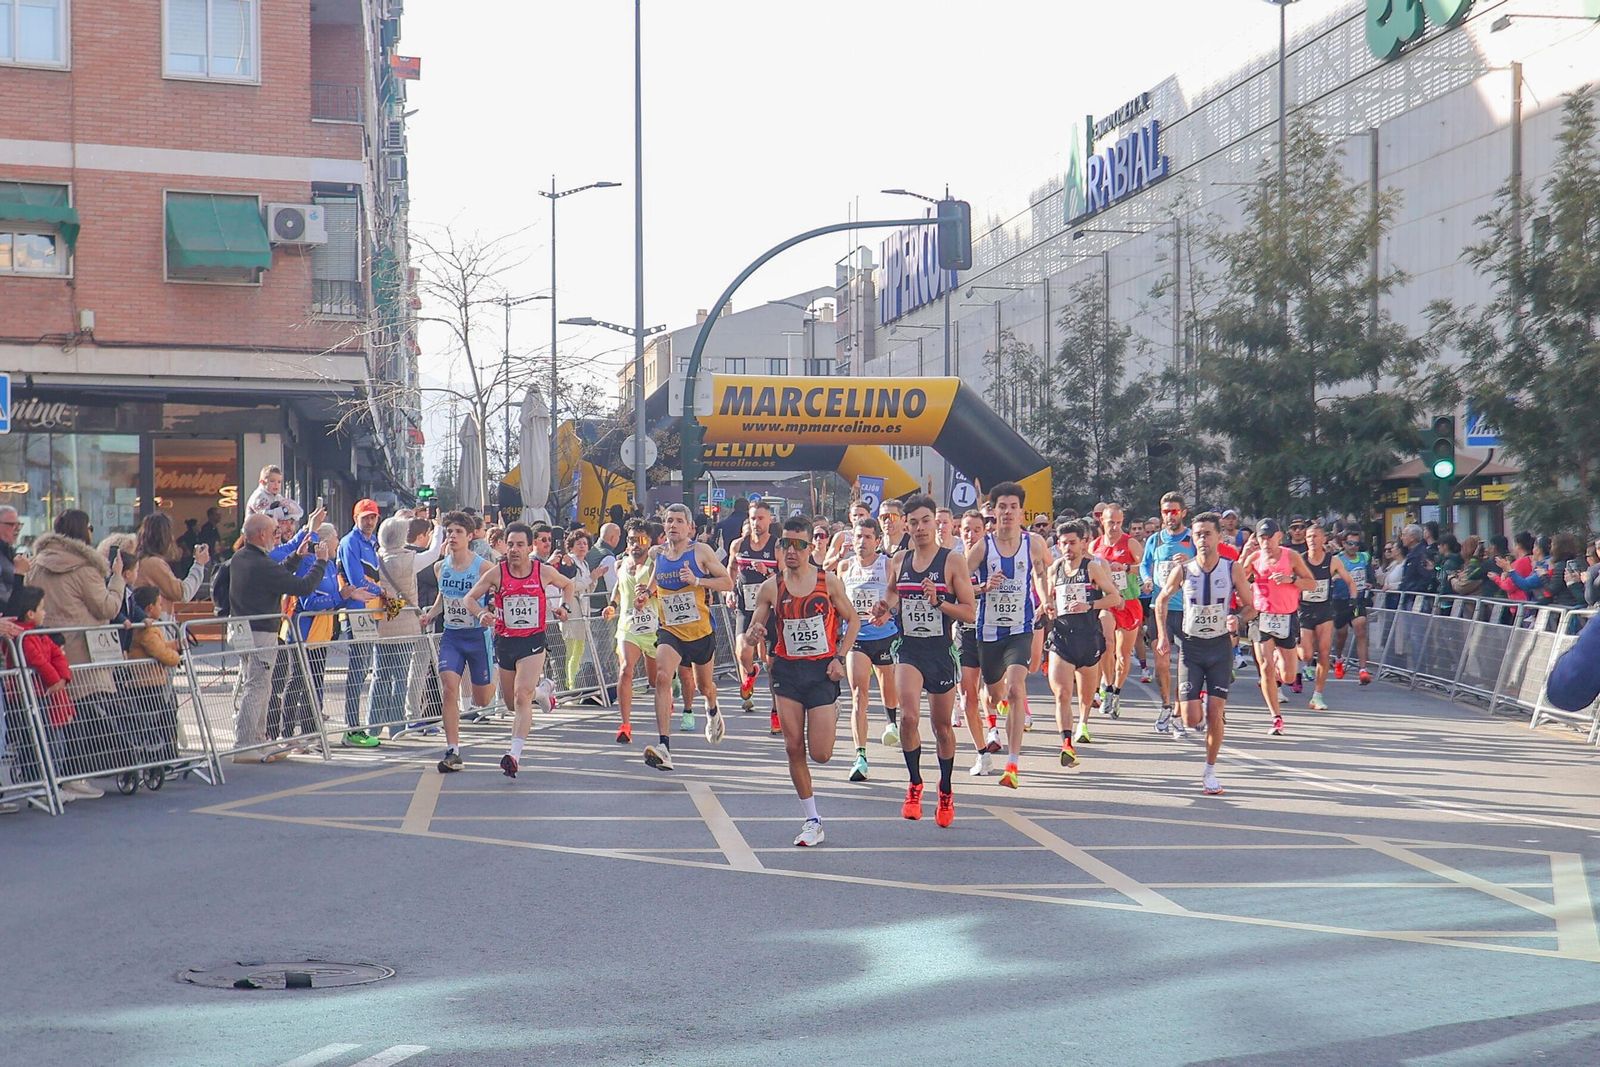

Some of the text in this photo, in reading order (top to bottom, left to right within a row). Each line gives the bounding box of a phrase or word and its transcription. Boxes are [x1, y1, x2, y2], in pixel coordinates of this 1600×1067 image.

[718, 386, 927, 418] MARCELINO
[742, 421, 902, 436] www.mpmarcelino.es
[959, 486, 970, 504] 1
[442, 578, 473, 591] nerja
[447, 606, 467, 616] 2948
[510, 607, 532, 616] 1941
[668, 602, 691, 613] 1363
[993, 604, 1017, 613] 1832
[631, 614, 651, 625] 1769
[907, 612, 934, 622] 1515
[1194, 616, 1218, 624] 2318
[791, 630, 819, 641] 1255
